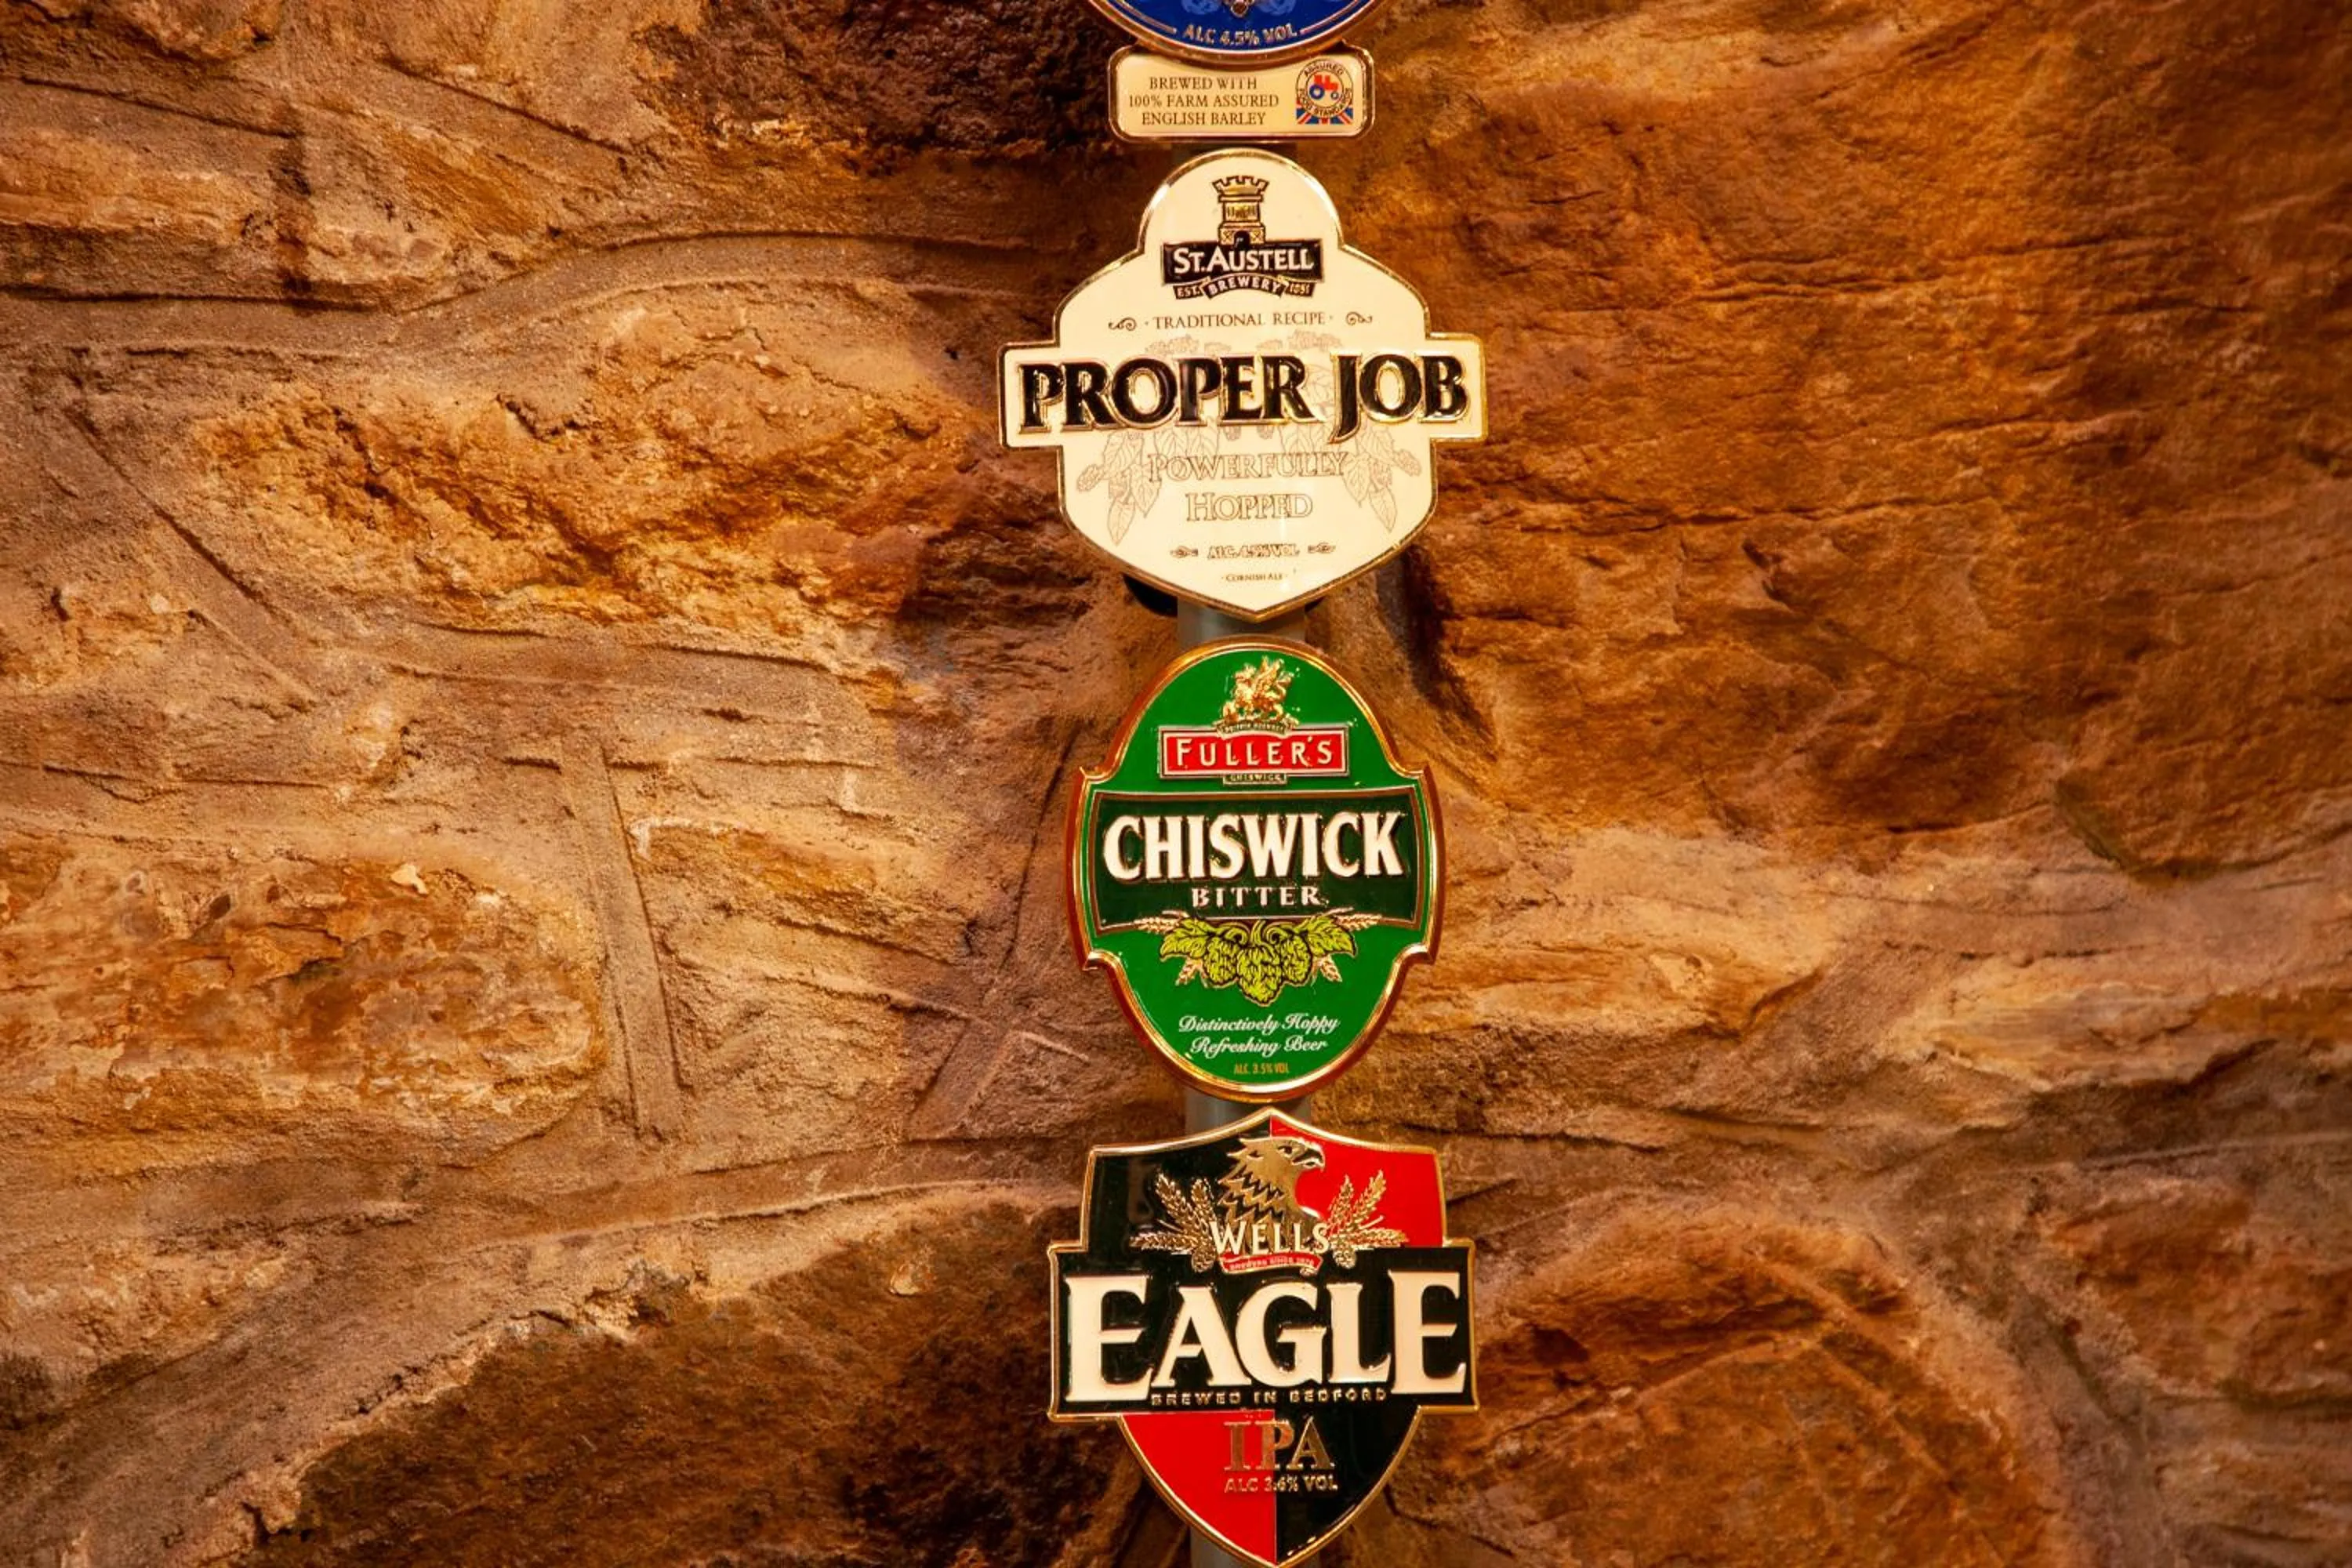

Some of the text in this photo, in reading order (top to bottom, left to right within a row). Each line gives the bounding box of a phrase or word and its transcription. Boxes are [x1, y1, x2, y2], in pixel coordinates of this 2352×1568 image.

[1183, 23, 1298, 45] ALC 4.5% VOL
[1149, 77, 1257, 90] BREWED WITH
[1129, 94, 1279, 107] 100% FARM ASSURED
[1142, 111, 1267, 125] ENGLISH BARLEY
[1208, 275, 1284, 296] BREWERY
[1152, 312, 1326, 330] TRADITIONAL RECIPE
[1017, 351, 1471, 445] PROPER JOB
[1147, 452, 1350, 483] POWERFULLY
[1185, 492, 1314, 521] HOPPED
[1225, 573, 1266, 582] CORNISH
[1175, 735, 1334, 767] FULLER'S
[1102, 811, 1406, 880] CHISWICK
[1191, 885, 1329, 908] BITTER
[1178, 1012, 1341, 1036] Distinctively Hoppy
[1189, 1035, 1328, 1059] Refreshing Beer
[1275, 1062, 1290, 1074] VOL
[1209, 1221, 1330, 1254] WELLS
[1065, 1269, 1466, 1403] EAGLE
[1151, 1388, 1387, 1406] BREWED IN BEDFORD
[1224, 1414, 1336, 1471] IPA
[1224, 1474, 1338, 1494] ALC 3.6% VOL
